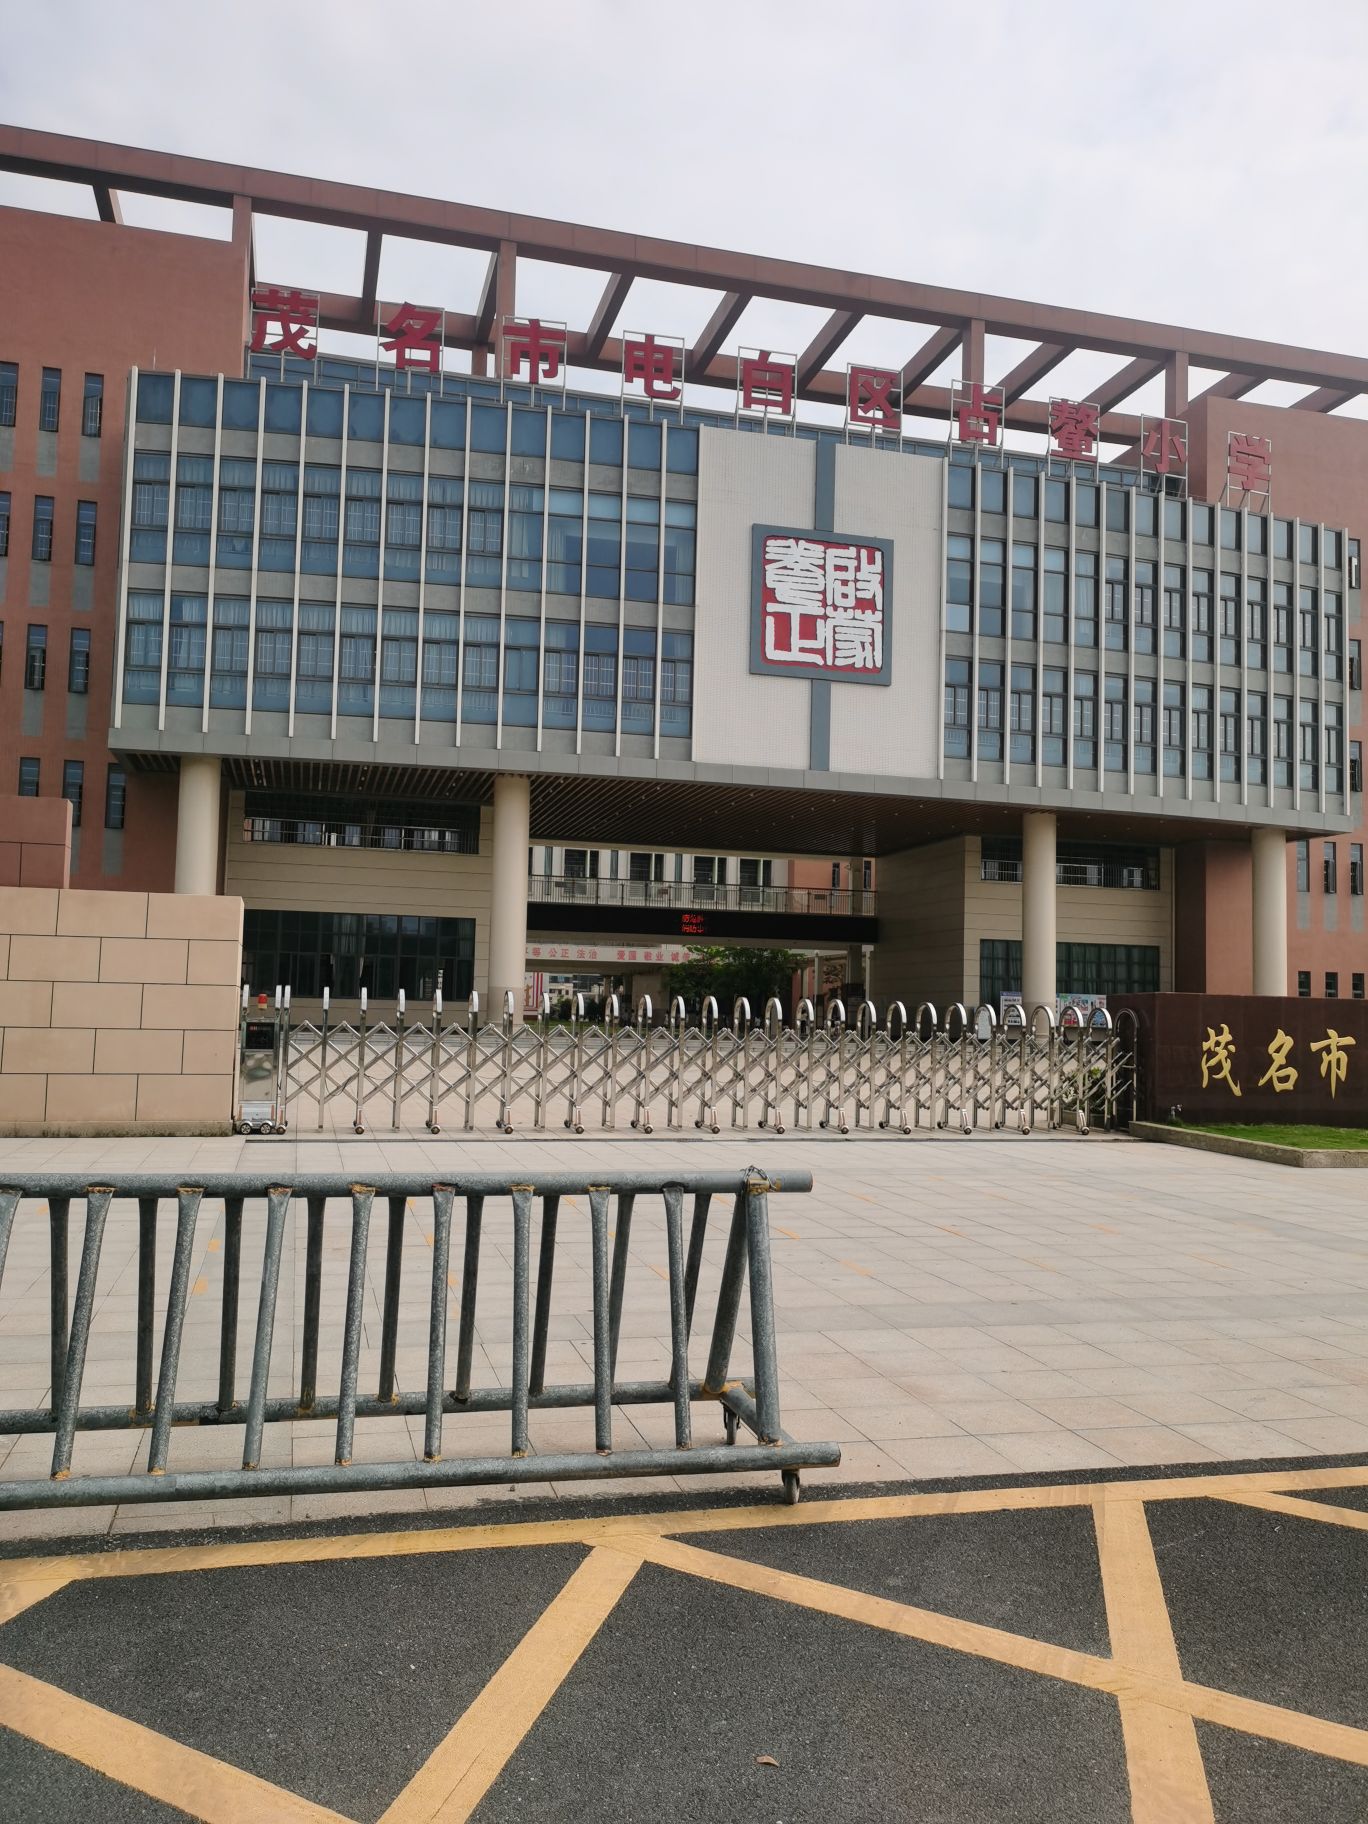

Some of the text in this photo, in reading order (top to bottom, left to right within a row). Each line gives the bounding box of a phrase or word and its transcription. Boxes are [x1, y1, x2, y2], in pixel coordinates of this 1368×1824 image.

[251, 288, 1270, 490] 茂名市电白区占鳌小学
[1201, 1023, 1356, 1100] 茂名市
